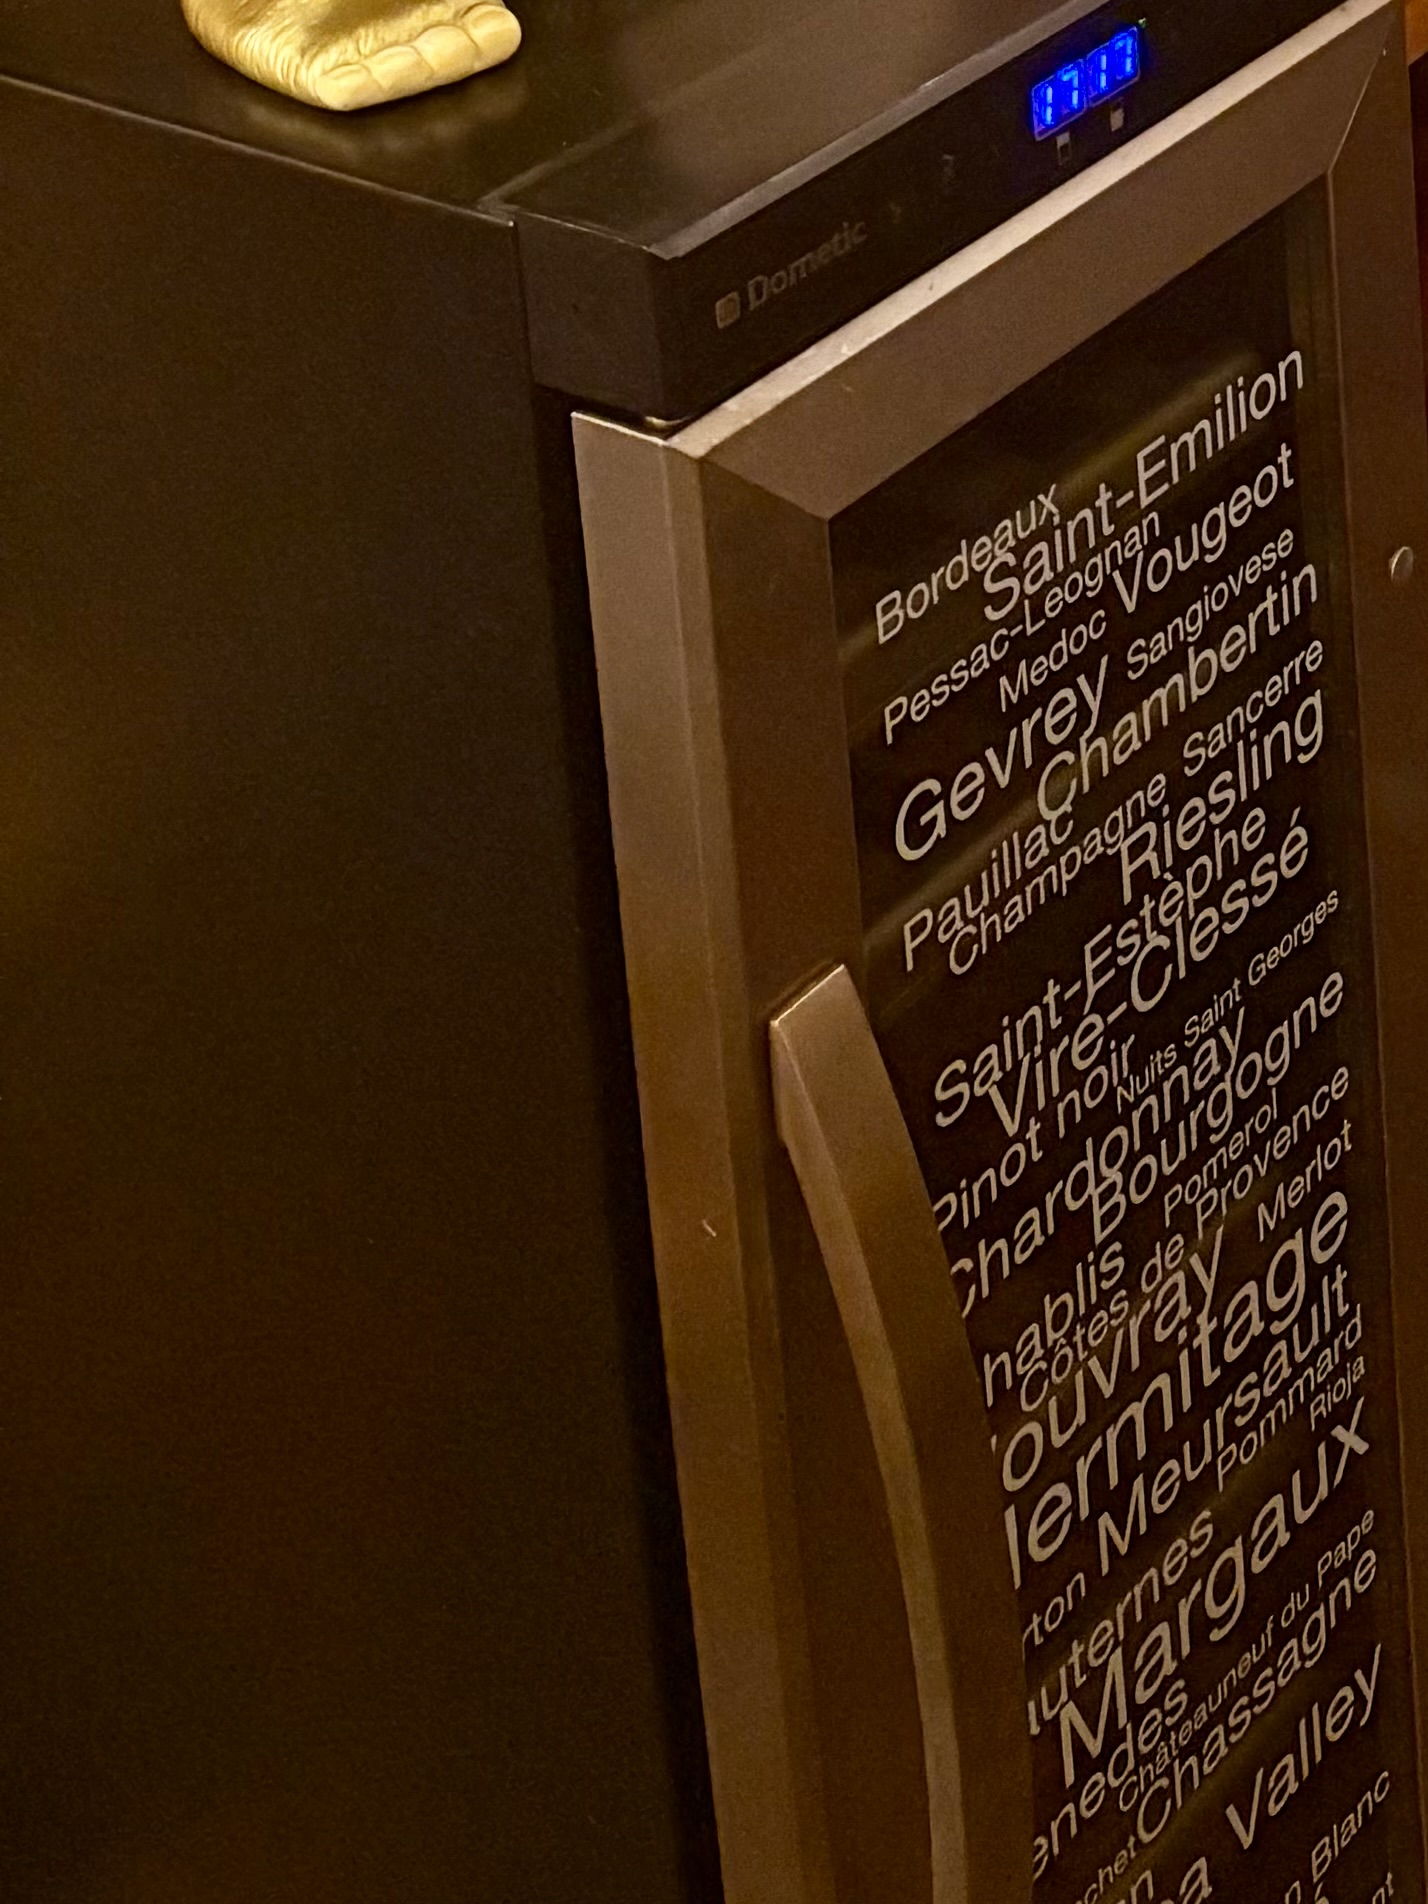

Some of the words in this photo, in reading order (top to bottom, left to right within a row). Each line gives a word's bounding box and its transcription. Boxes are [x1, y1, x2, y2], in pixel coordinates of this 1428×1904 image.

[747, 221, 869, 312] Dometic
[875, 483, 1060, 645] Bordeaux
[983, 350, 1304, 621] Saint-Emilion
[999, 609, 1107, 713] Medoc
[1111, 442, 1295, 613] Vougeot
[884, 511, 1160, 747] Pessac-Leognan
[895, 653, 1109, 862] Gevrey
[1127, 528, 1295, 681] Sangiovese
[1037, 563, 1318, 820] Chambertin
[903, 809, 1074, 973] Pauillac
[1183, 640, 1323, 777] Sancerre
[949, 772, 1167, 975] Champagne
[1119, 689, 1324, 907] Riesling
[934, 807, 1266, 1128] Saint-Estèphe
[1057, 1034, 1136, 1139] noir
[1117, 1044, 1178, 1114] Nuits
[1184, 978, 1242, 1047] Saint
[1248, 890, 1340, 987] Georges
[1093, 972, 1344, 1246] Bourgogne
[1164, 1087, 1278, 1228] Pomerol
[1195, 1066, 1349, 1241] Provence
[1257, 1119, 1353, 1242] Merlot
[983, 1241, 1123, 1408] hablis
[990, 1224, 1224, 1493] ouvray
[1020, 1289, 1129, 1412] Côtes
[1141, 1233, 1185, 1293] de
[1098, 1264, 1350, 1577] Meursault
[1216, 1303, 1362, 1493] Pommard
[1310, 1355, 1366, 1432] Rioja
[1059, 1395, 1370, 1790] Margaux
[1281, 1583, 1309, 1628] du
[1317, 1509, 1375, 1588] Pape
[1032, 1678, 1189, 1879] enedes
[1136, 1548, 1377, 1844] Chassagne
[1224, 1642, 1383, 1851] Valley
[1312, 1770, 1390, 1885] Blanc
